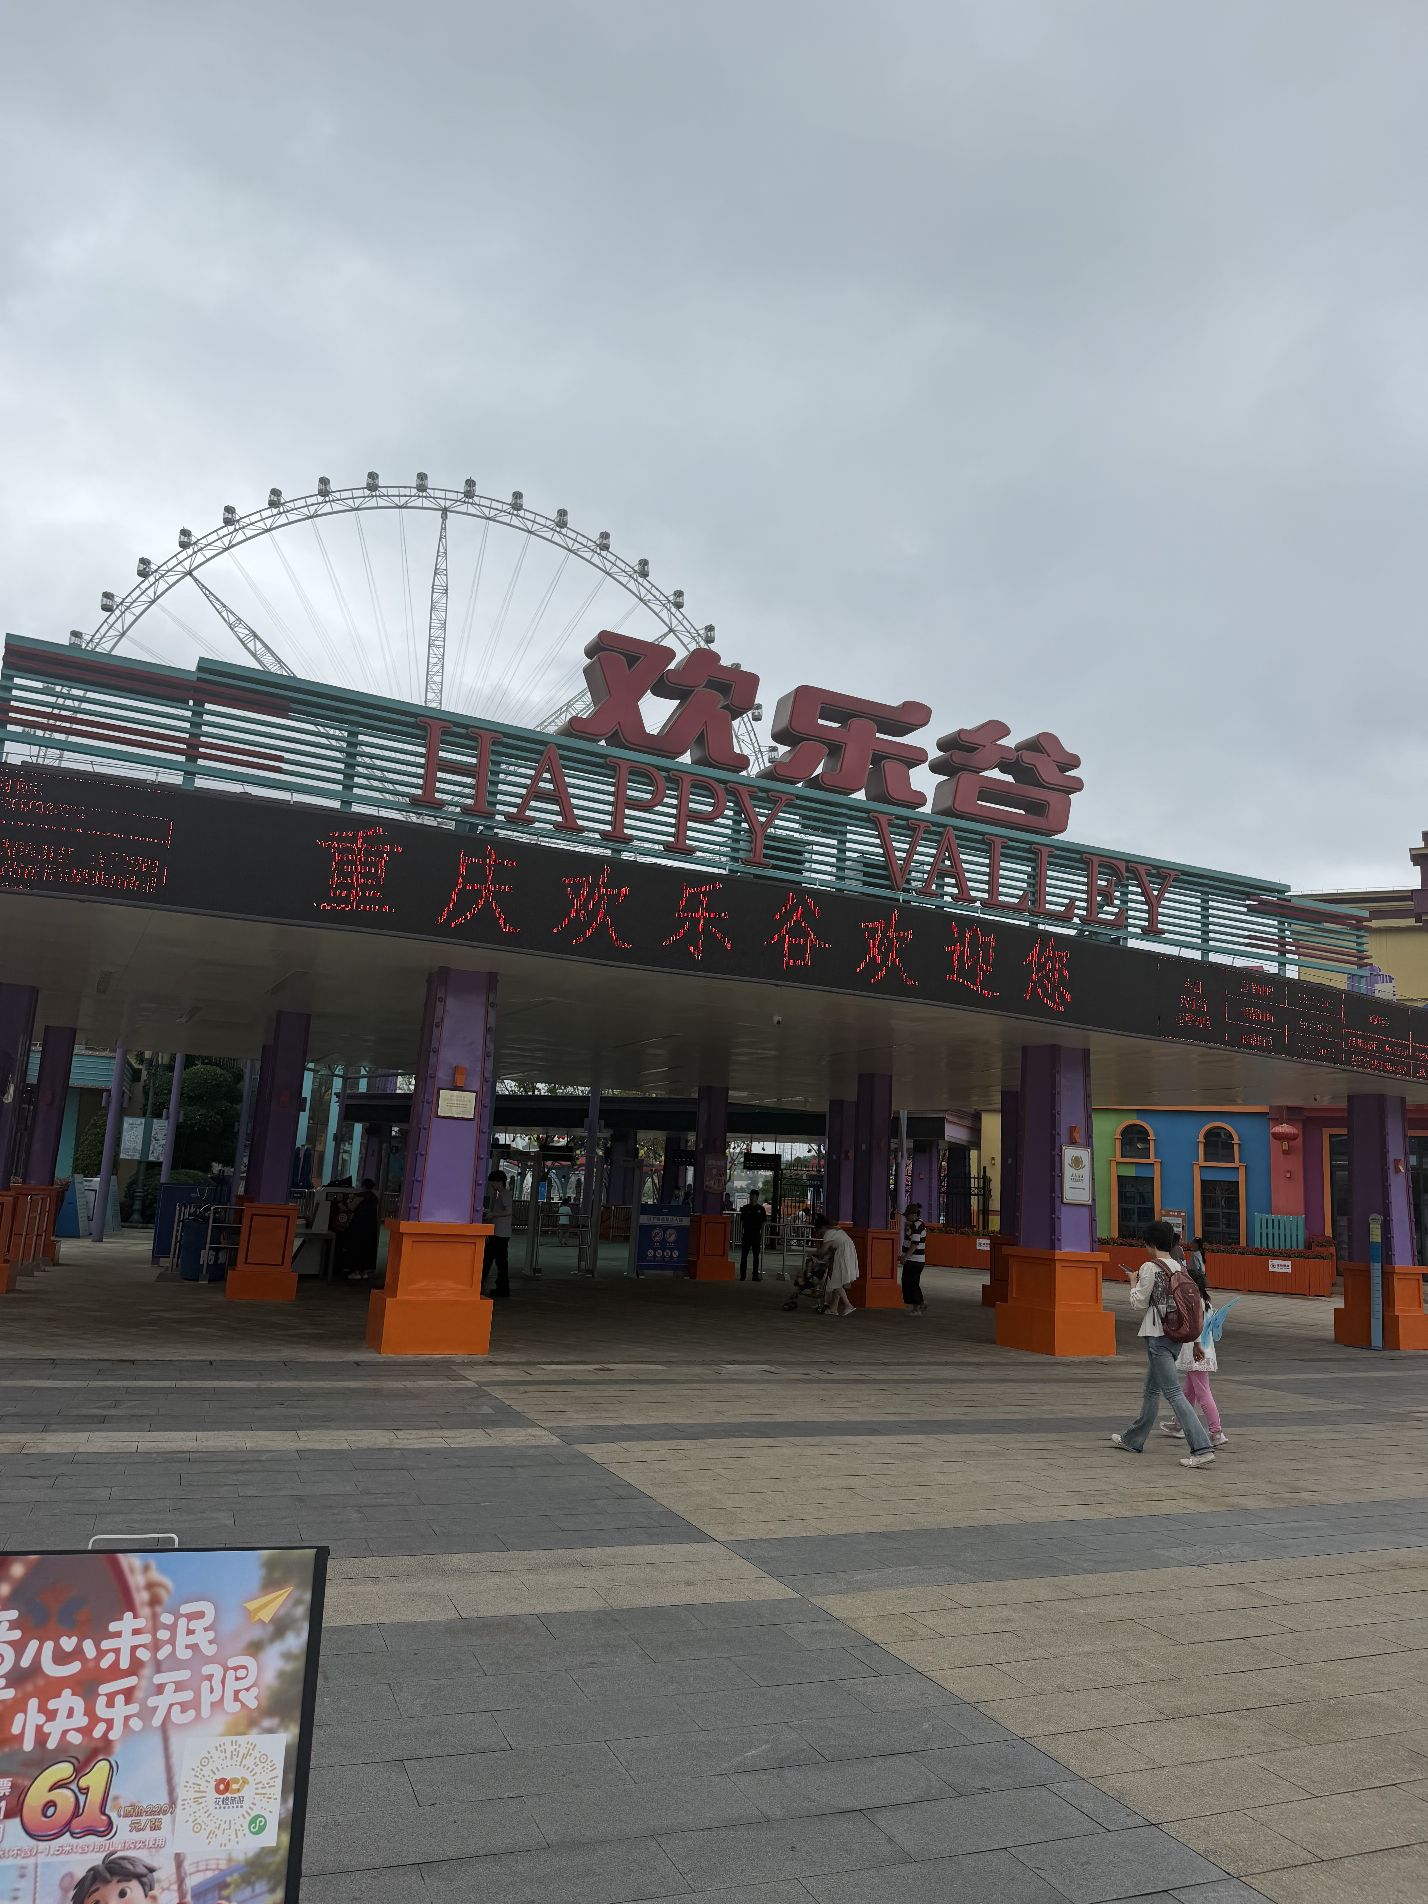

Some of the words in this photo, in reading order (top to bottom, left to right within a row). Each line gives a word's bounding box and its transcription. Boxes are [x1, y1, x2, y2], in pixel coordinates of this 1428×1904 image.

[562, 629, 1085, 836] 欢乐谷
[409, 716, 797, 868] HAPPY
[869, 812, 1182, 936] VALLEY
[312, 826, 1073, 1012] 重庆欢乐谷欢迎您
[11, 1655, 260, 1752] 快乐无限
[20, 1759, 115, 1841] 61
[129, 1817, 163, 1832] 元/张
